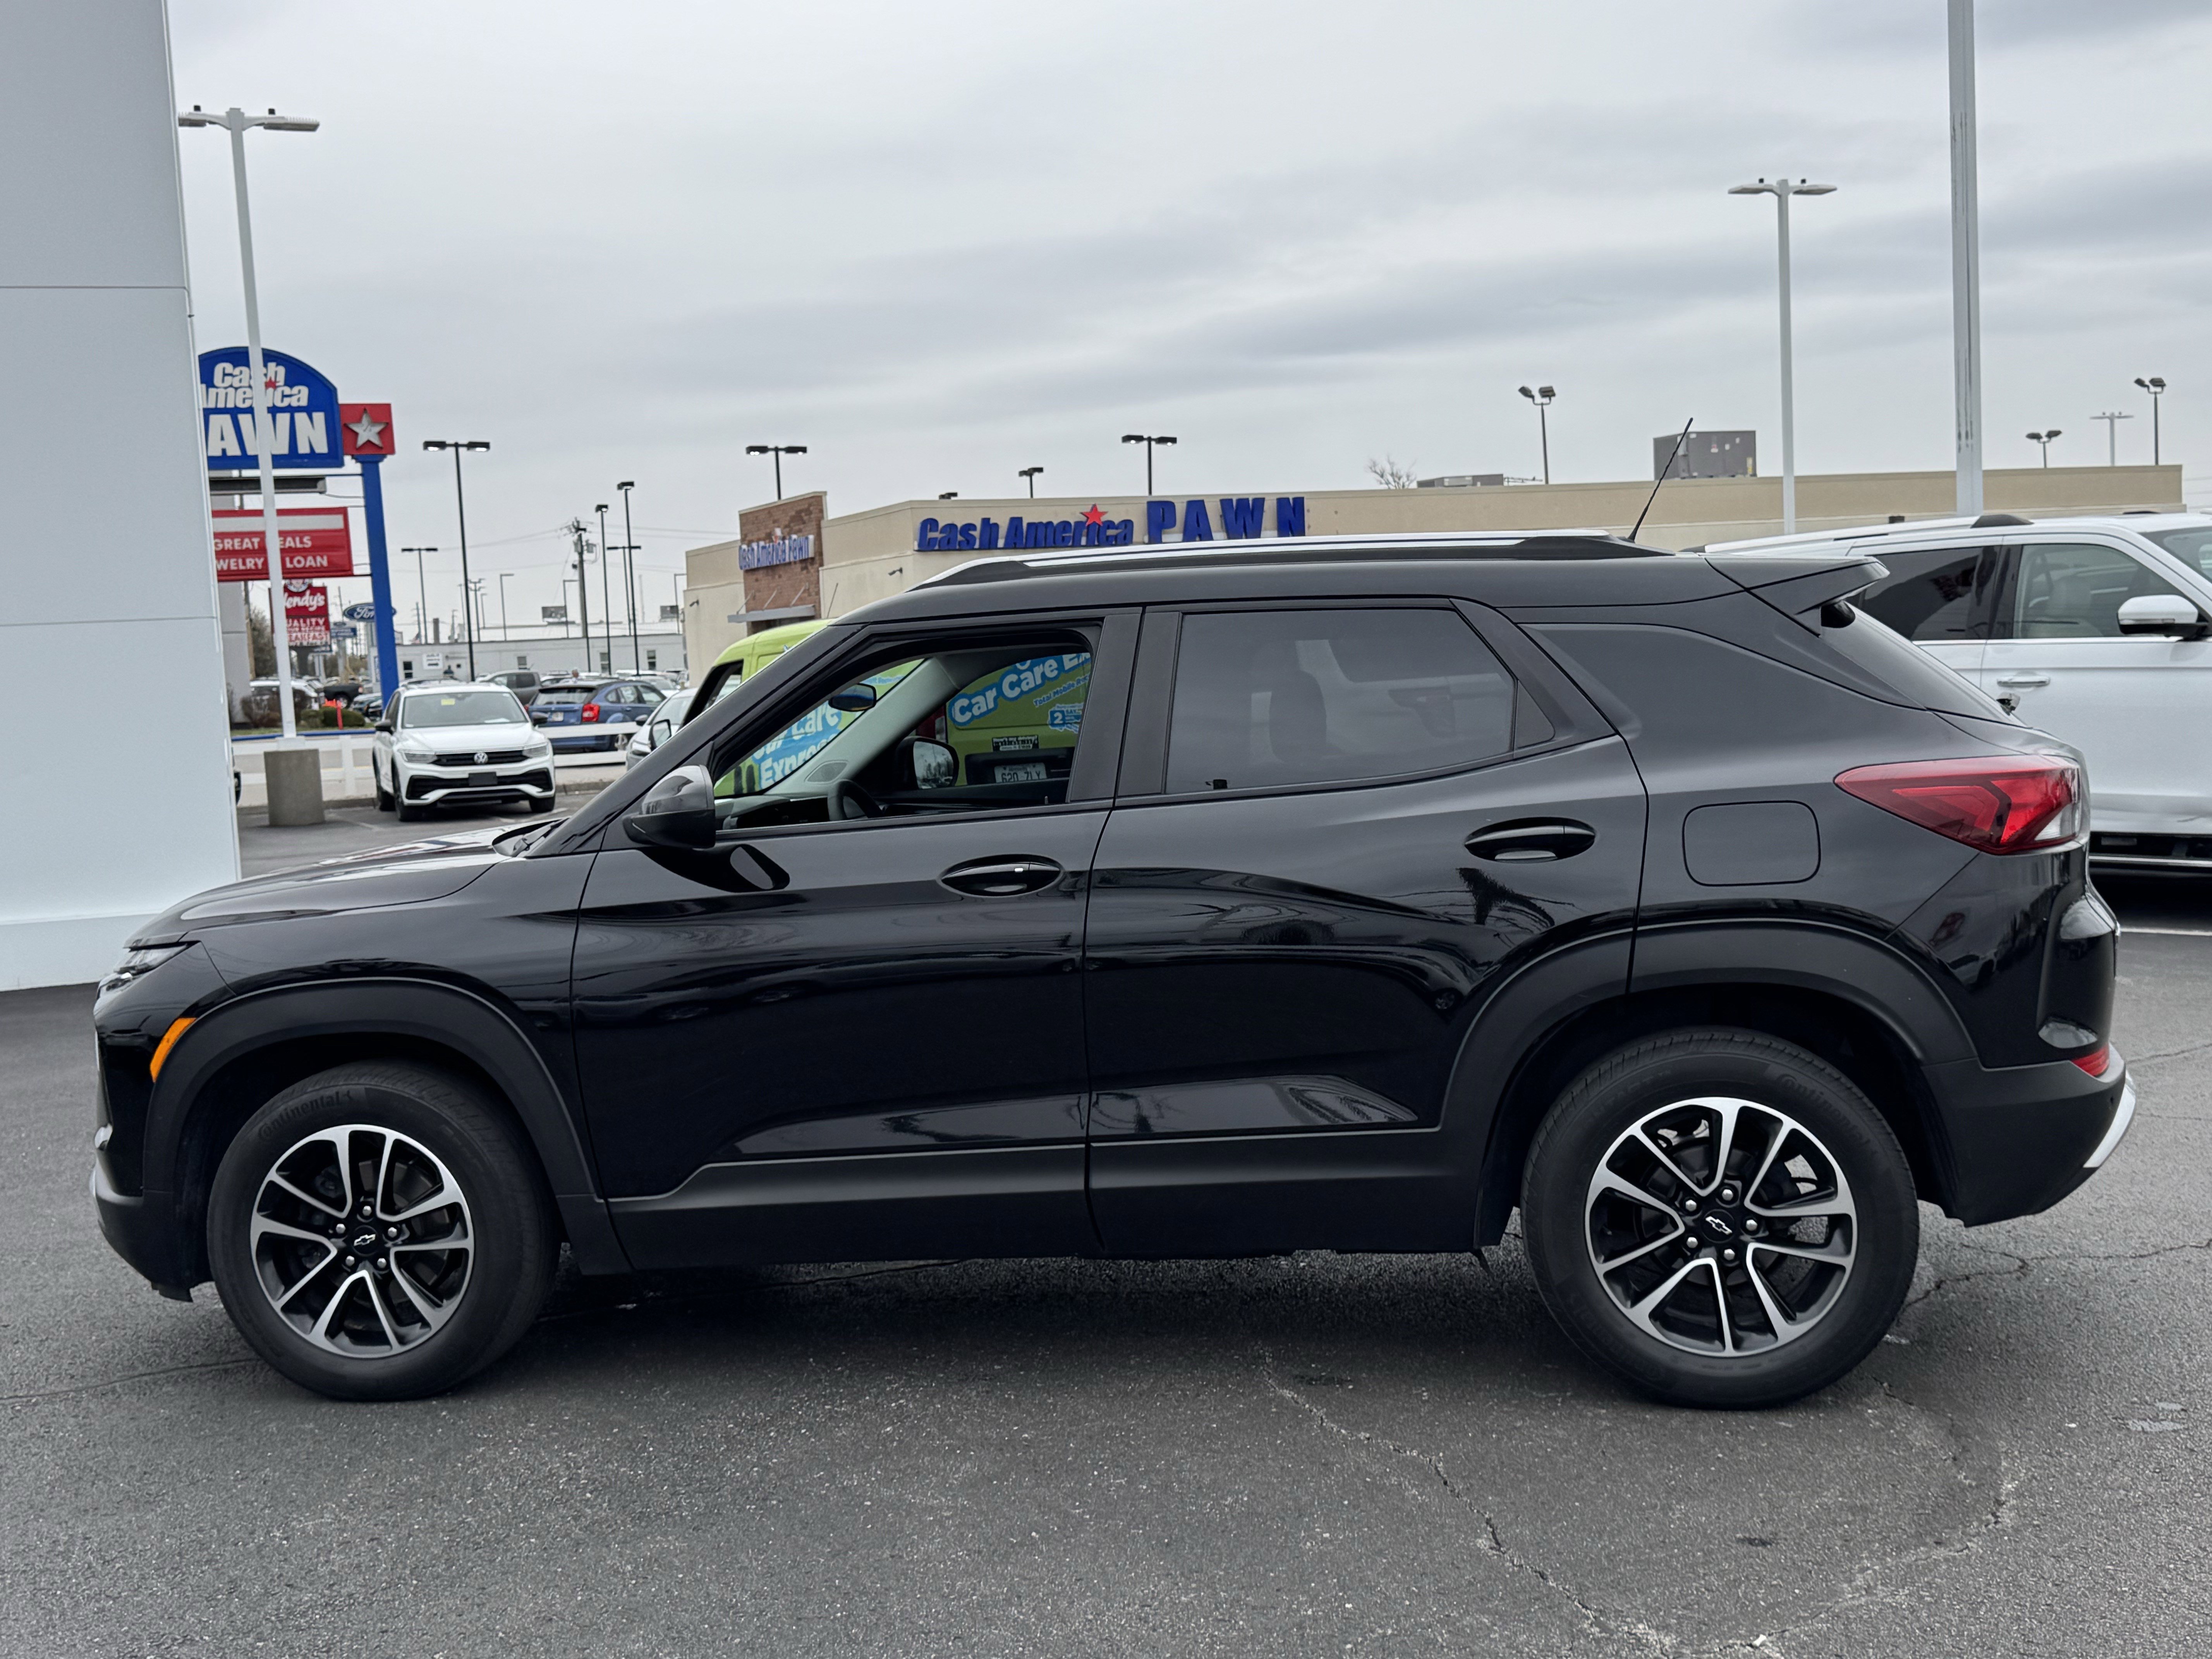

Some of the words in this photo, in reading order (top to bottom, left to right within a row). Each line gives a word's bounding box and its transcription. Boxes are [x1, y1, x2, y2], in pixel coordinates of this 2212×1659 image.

[208, 412, 328, 456] AWN
[917, 518, 999, 550] Cash
[1004, 514, 1134, 548] America
[1147, 497, 1305, 544] PAWN
[214, 537, 260, 551] GREAT
[279, 536, 312, 548] EALS
[216, 557, 264, 570] WELRY
[285, 555, 328, 568] LOAN
[284, 589, 325, 611] endy's
[287, 618, 325, 627] UALITY
[952, 687, 997, 723] Car
[1002, 659, 1058, 698] Care
[1054, 712, 1063, 724] 2
